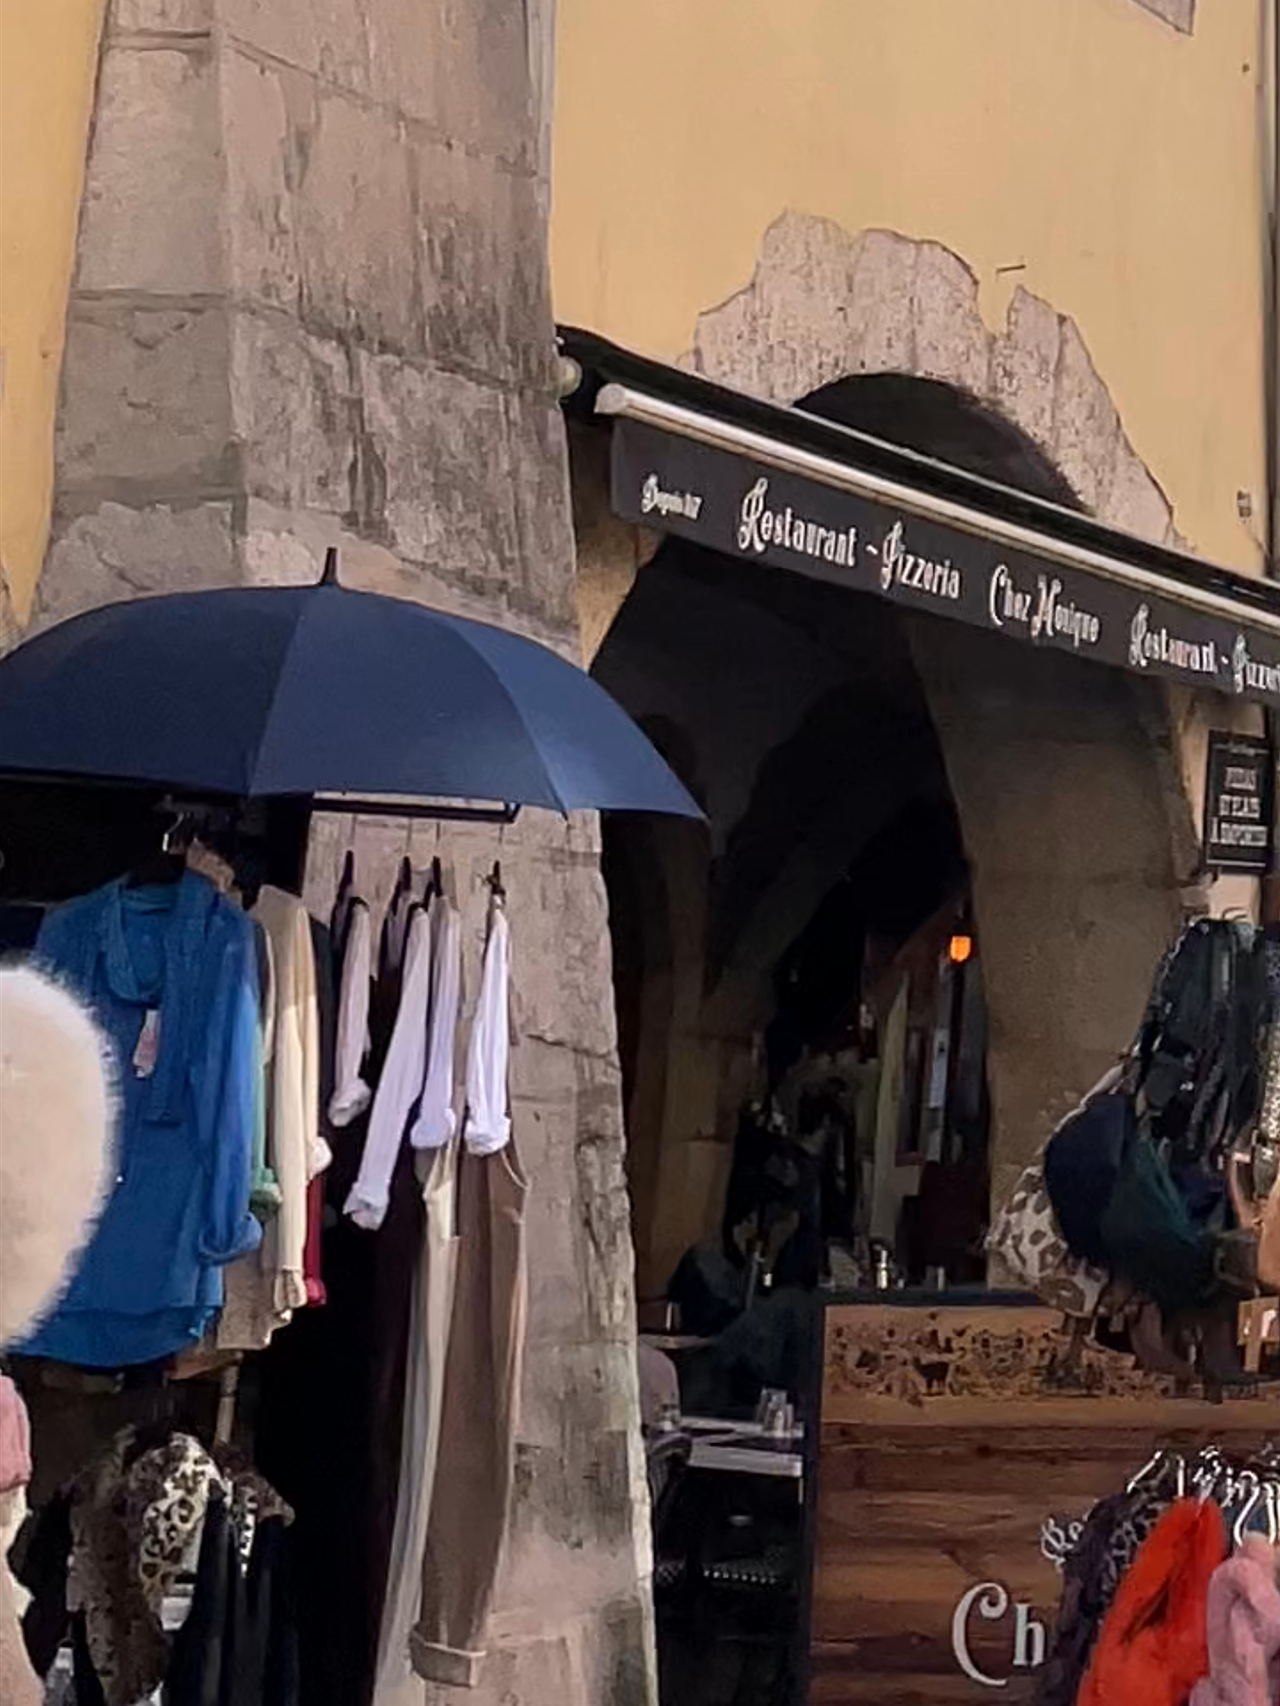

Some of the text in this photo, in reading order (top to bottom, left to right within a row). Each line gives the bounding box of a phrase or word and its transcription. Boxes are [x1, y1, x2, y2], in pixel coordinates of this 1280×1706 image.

[738, 477, 857, 567] Restaurant
[880, 520, 961, 599] Pizzeria
[989, 564, 1101, 647] Chez Monique
[952, 1582, 1046, 1686] Ch
